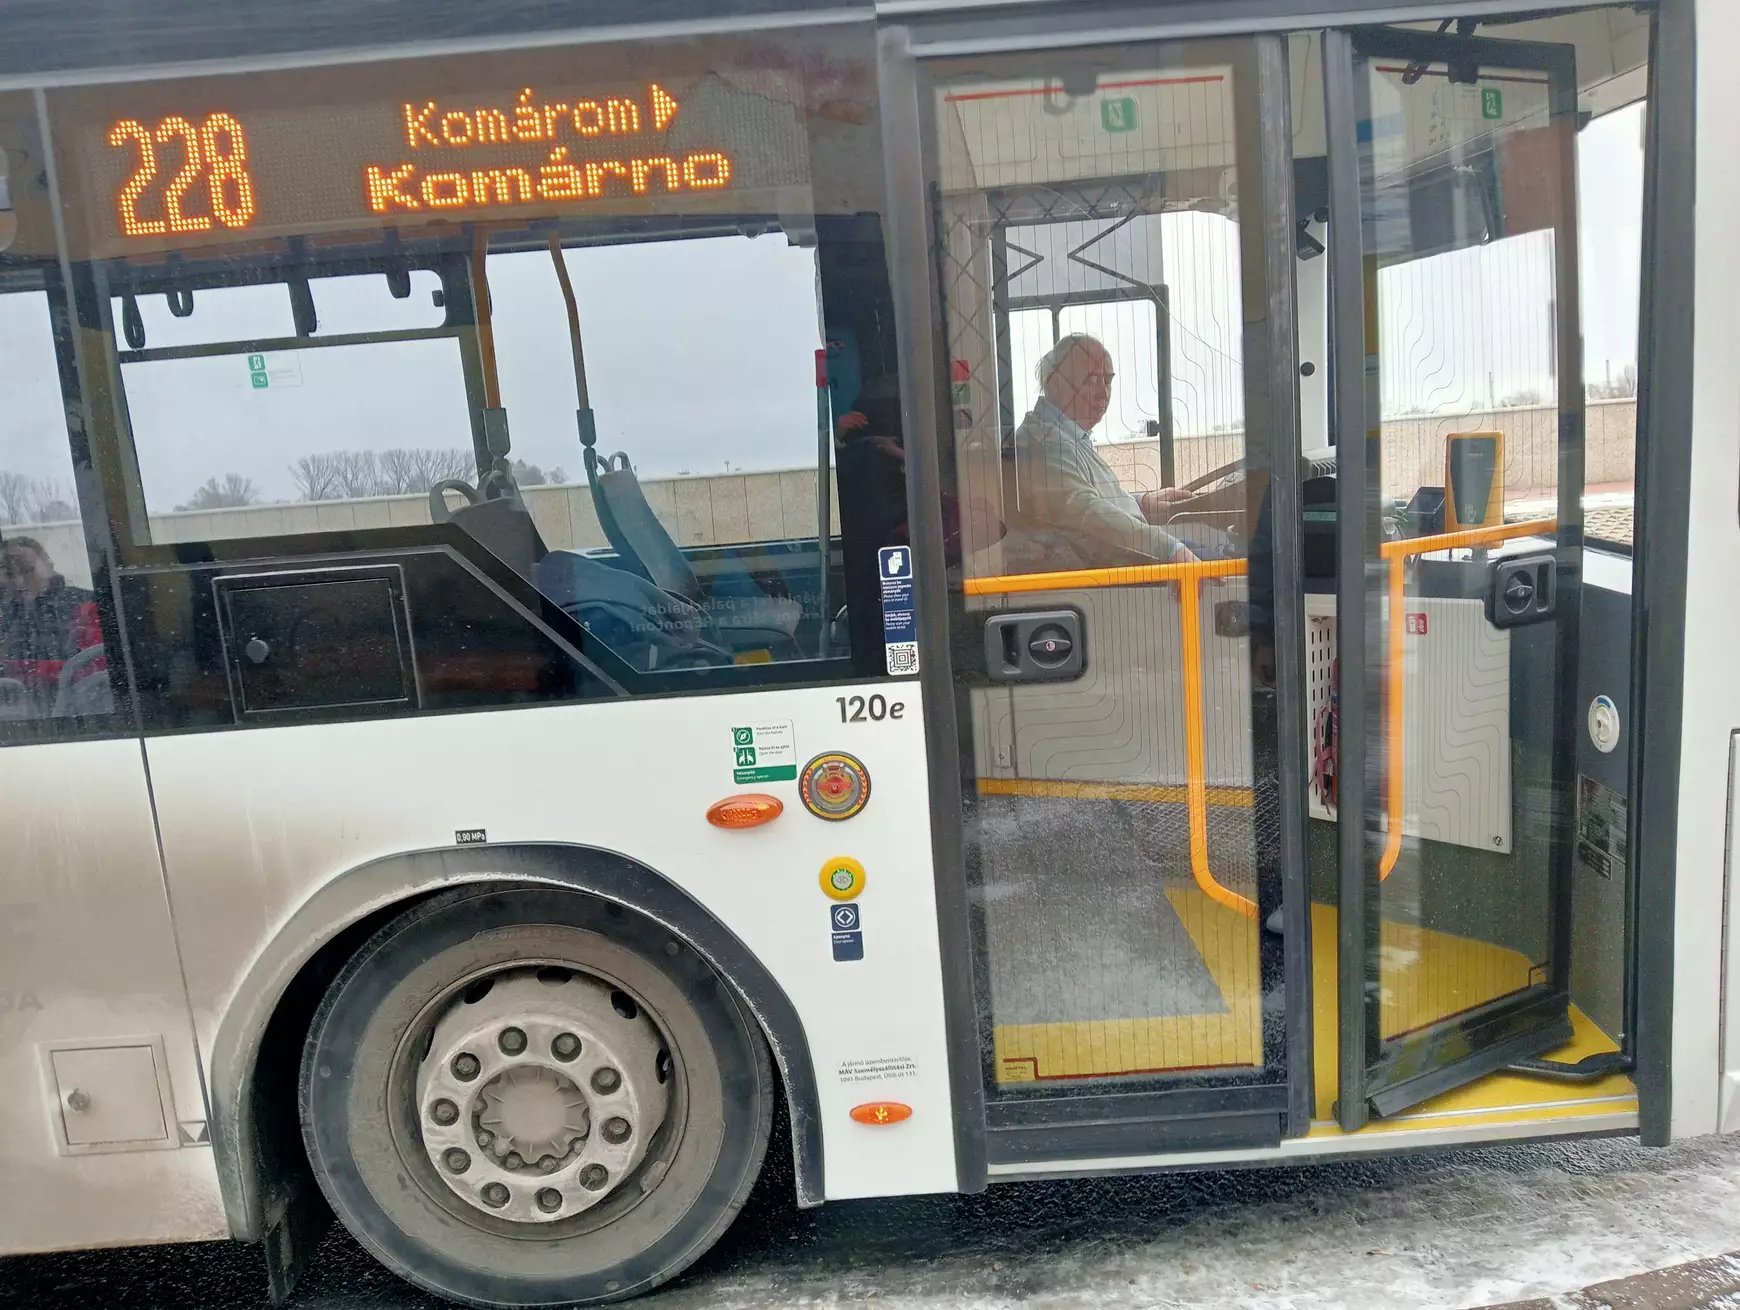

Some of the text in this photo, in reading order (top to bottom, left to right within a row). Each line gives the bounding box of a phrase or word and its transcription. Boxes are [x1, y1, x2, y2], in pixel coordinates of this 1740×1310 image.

[404, 87, 640, 148] Komárom
[109, 112, 254, 236] 228
[366, 146, 732, 214] Komárno
